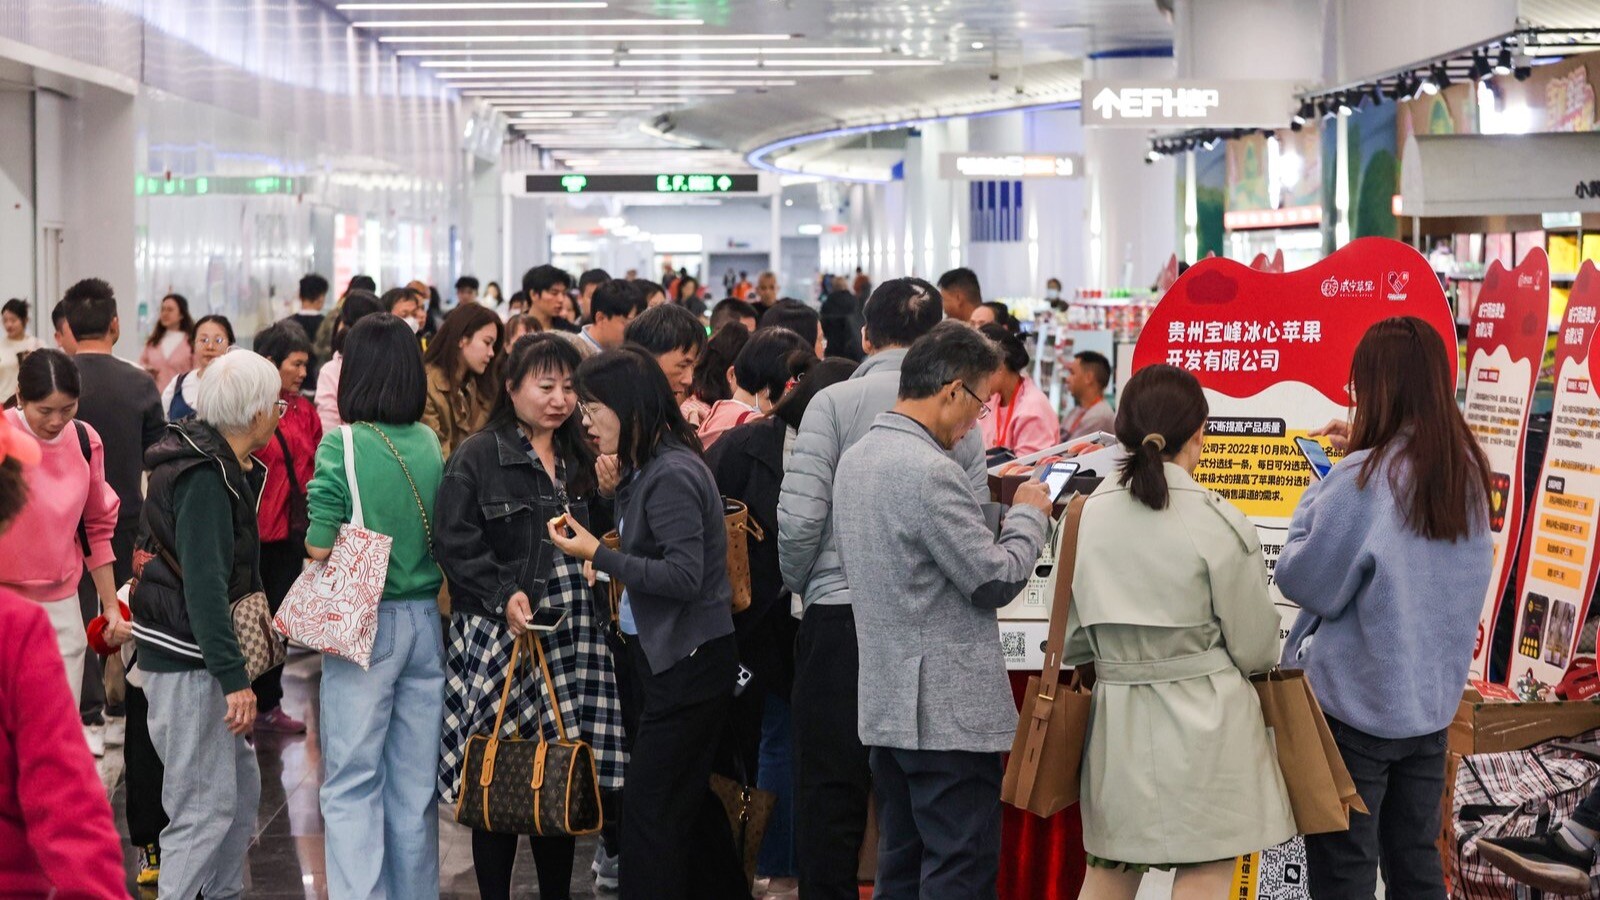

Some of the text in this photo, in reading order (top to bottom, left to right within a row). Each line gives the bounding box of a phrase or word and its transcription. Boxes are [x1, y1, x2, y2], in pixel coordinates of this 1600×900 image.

[1167, 320, 1322, 343] 贵州宝峰冰心苹果
[1165, 349, 1280, 372] 开发有限公司
[1206, 420, 1281, 434] 不断提高产品质量
[349, 540, 372, 578] America
